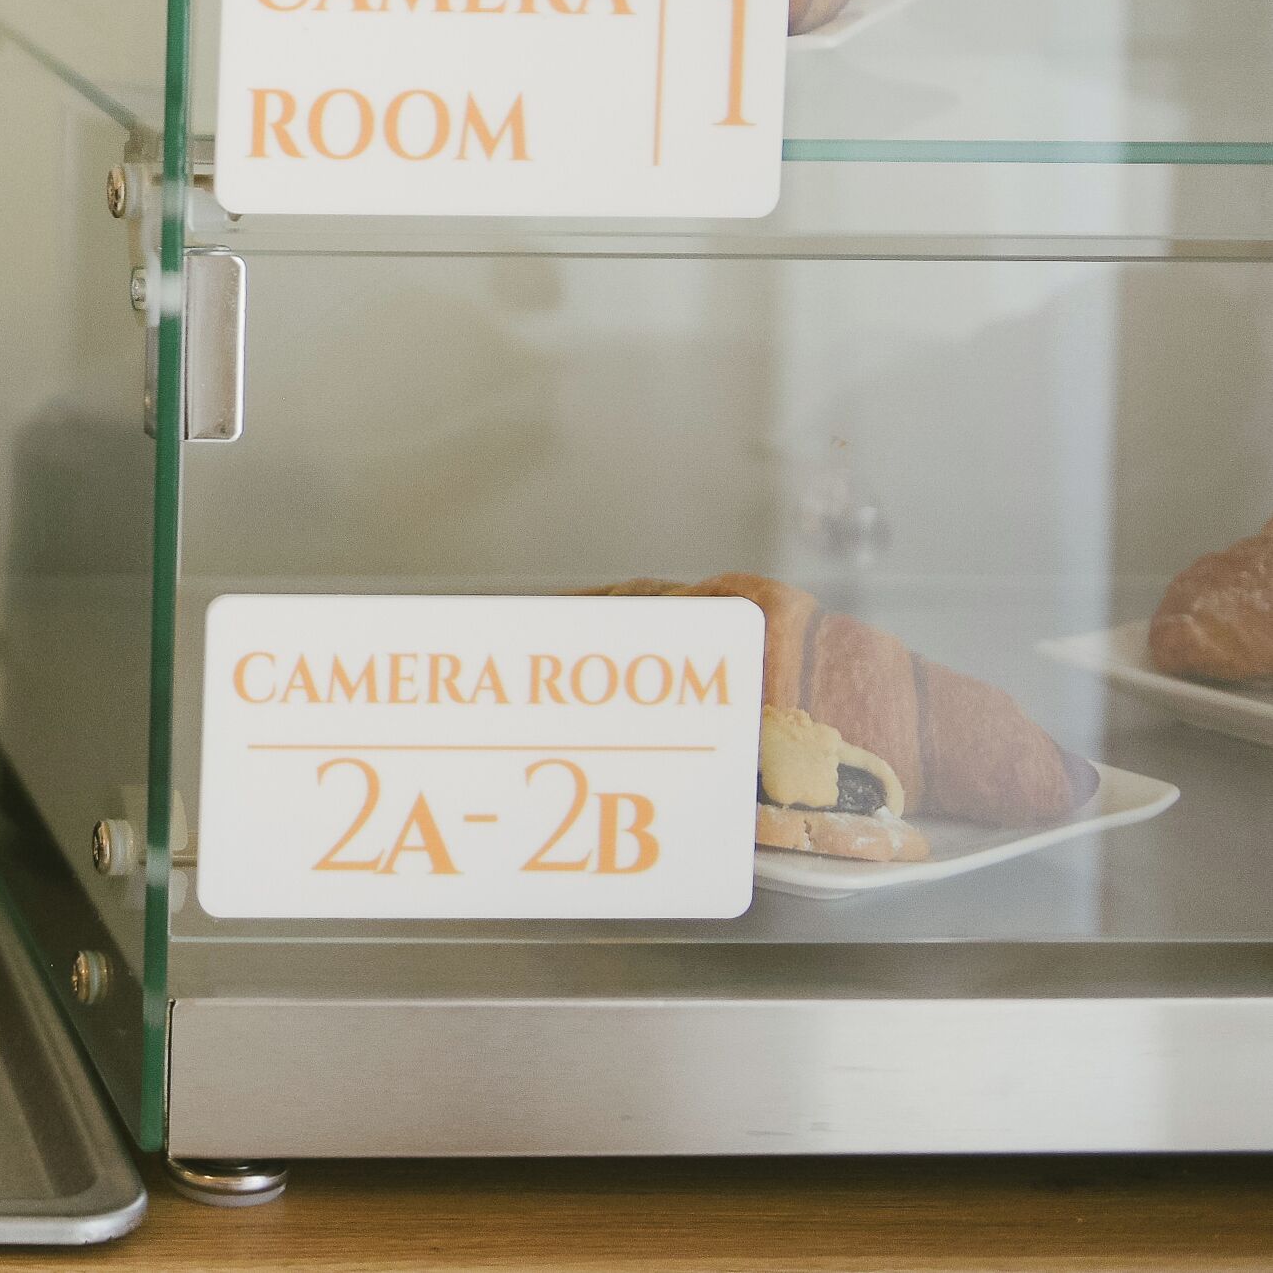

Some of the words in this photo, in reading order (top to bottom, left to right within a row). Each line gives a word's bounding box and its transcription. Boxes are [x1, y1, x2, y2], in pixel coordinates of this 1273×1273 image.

[245, 87, 532, 163] ROOM
[232, 651, 509, 706] CAMERA
[526, 653, 732, 707] ROOM
